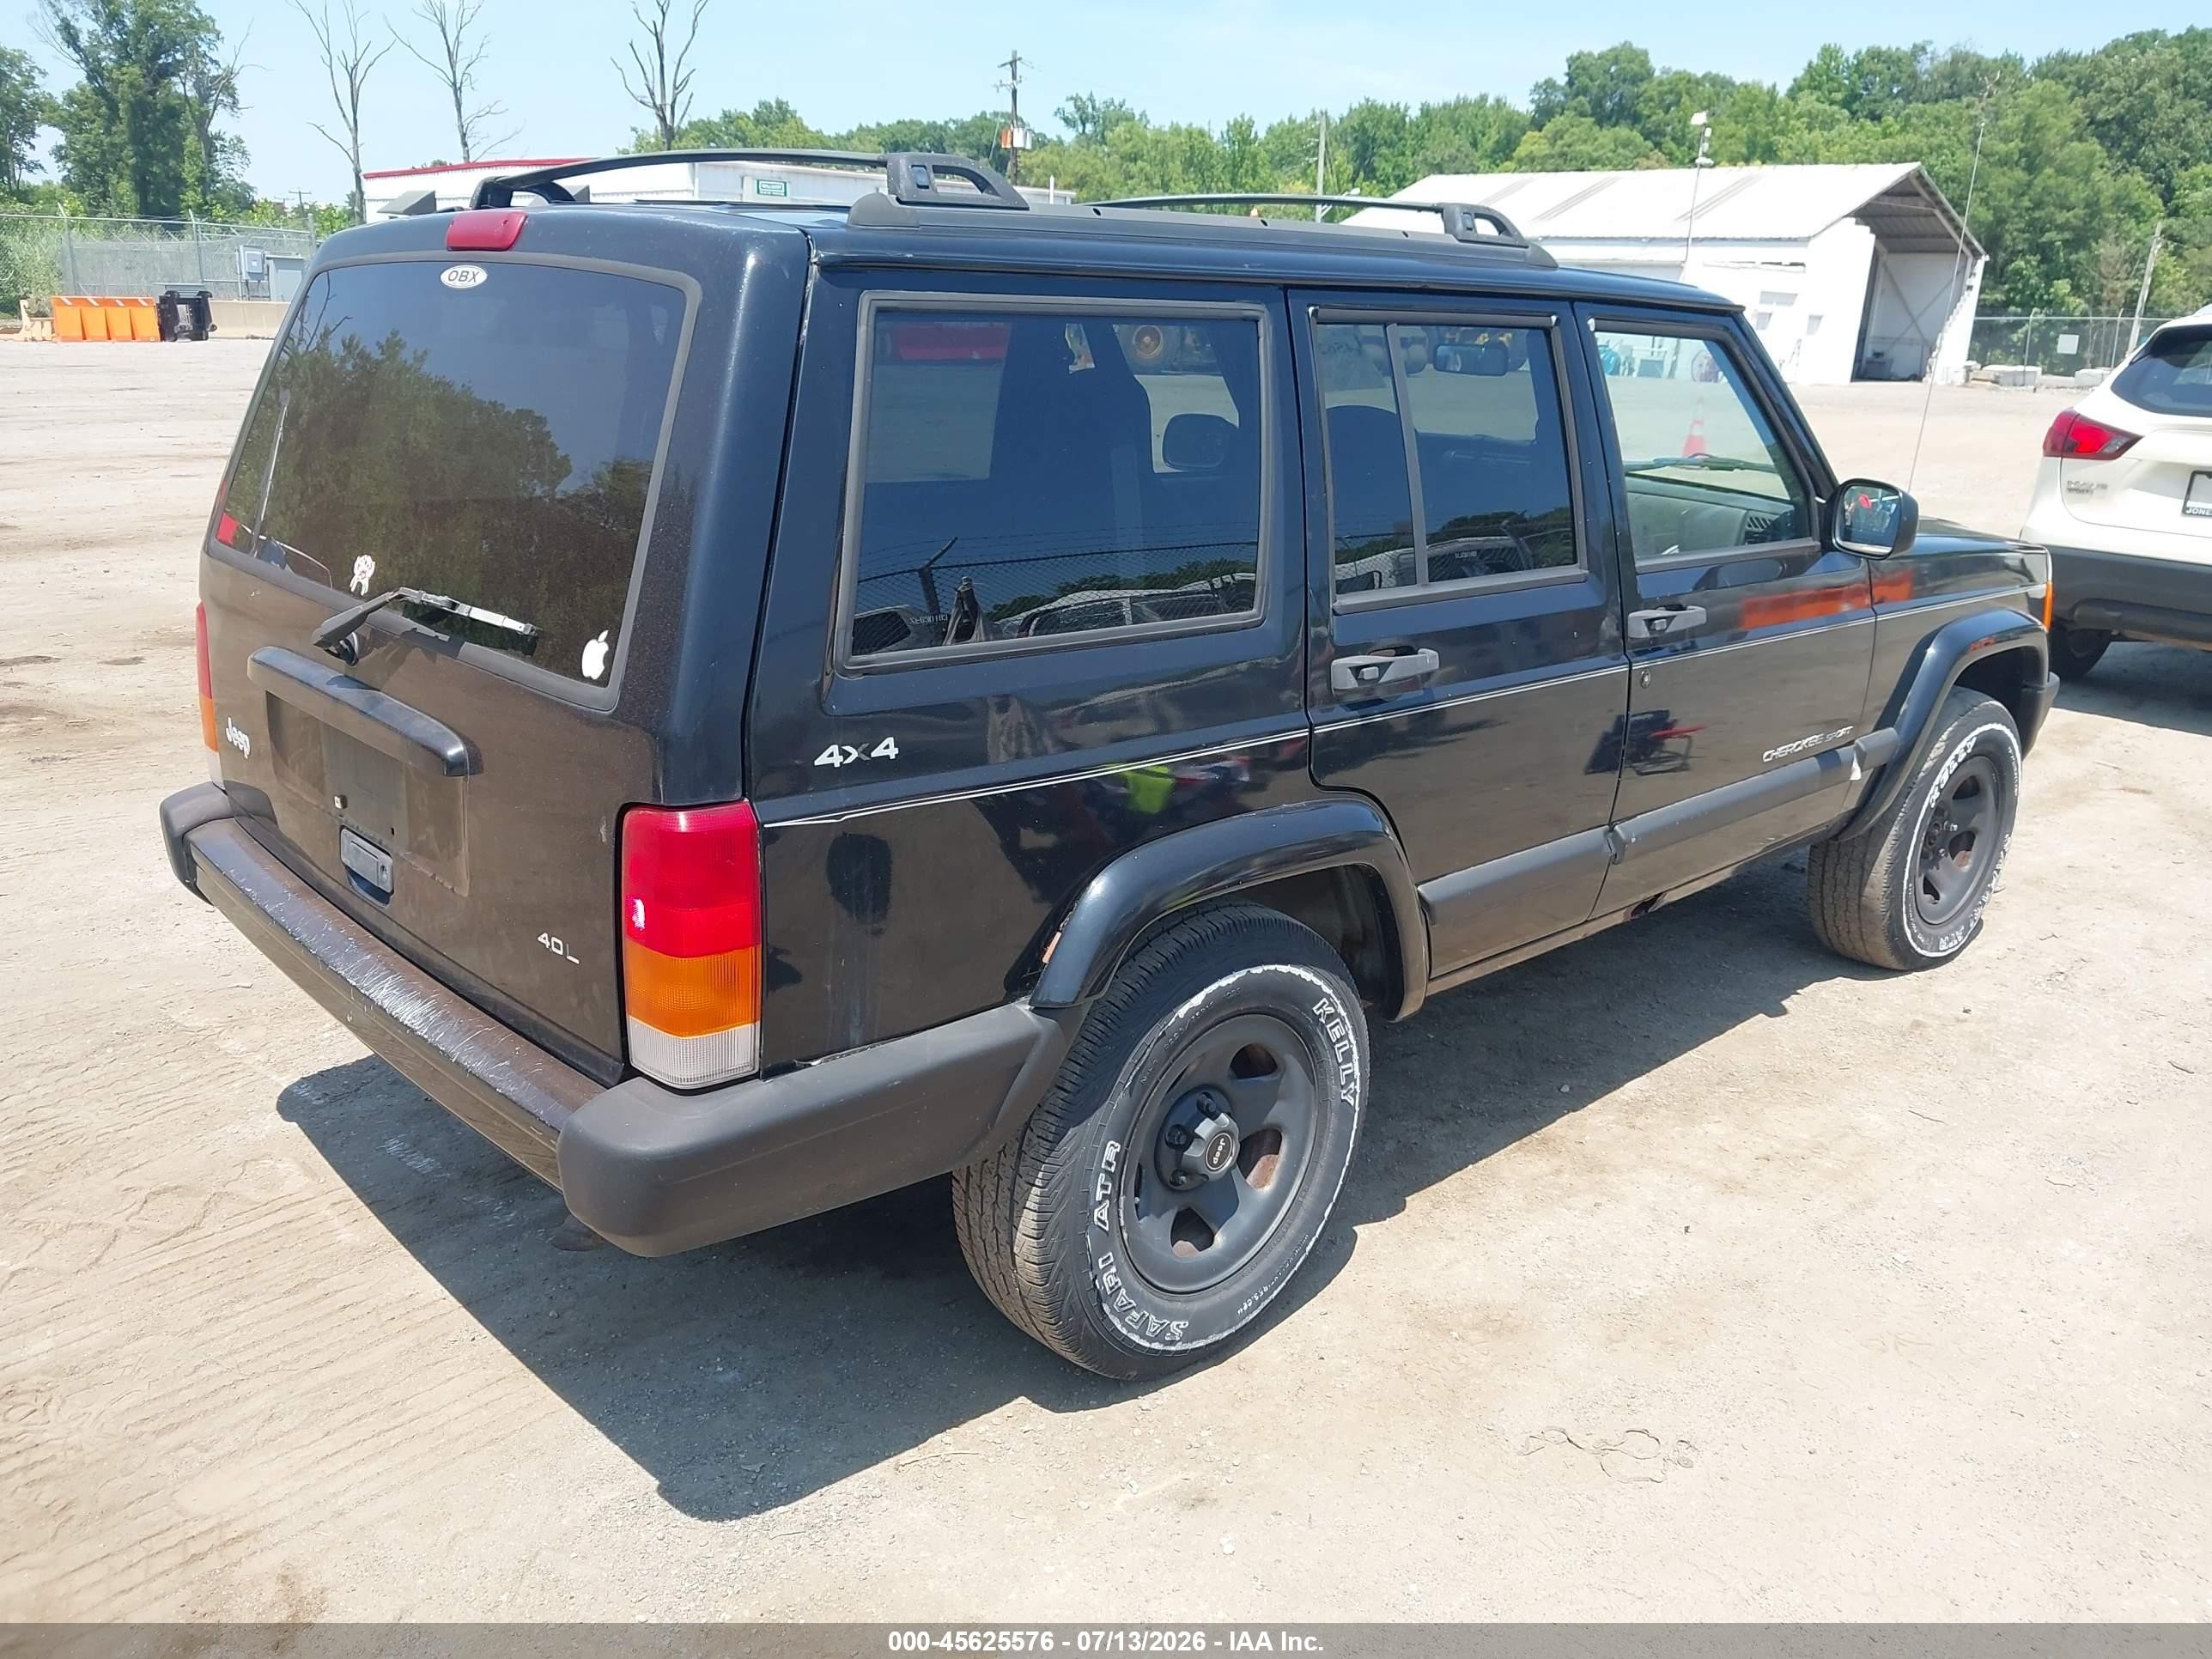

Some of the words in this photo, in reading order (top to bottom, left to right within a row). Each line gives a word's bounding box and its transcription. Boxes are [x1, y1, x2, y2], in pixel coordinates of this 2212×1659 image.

[447, 270, 480, 283] OBX
[225, 716, 251, 760] Jeep
[1762, 732, 1825, 763] CHEROKEE
[1311, 997, 1357, 1108] KELLY
[1212, 1138, 1226, 1164] Jeep
[1093, 1139, 1121, 1231] ATR
[1097, 1251, 1189, 1341] SAFARI
